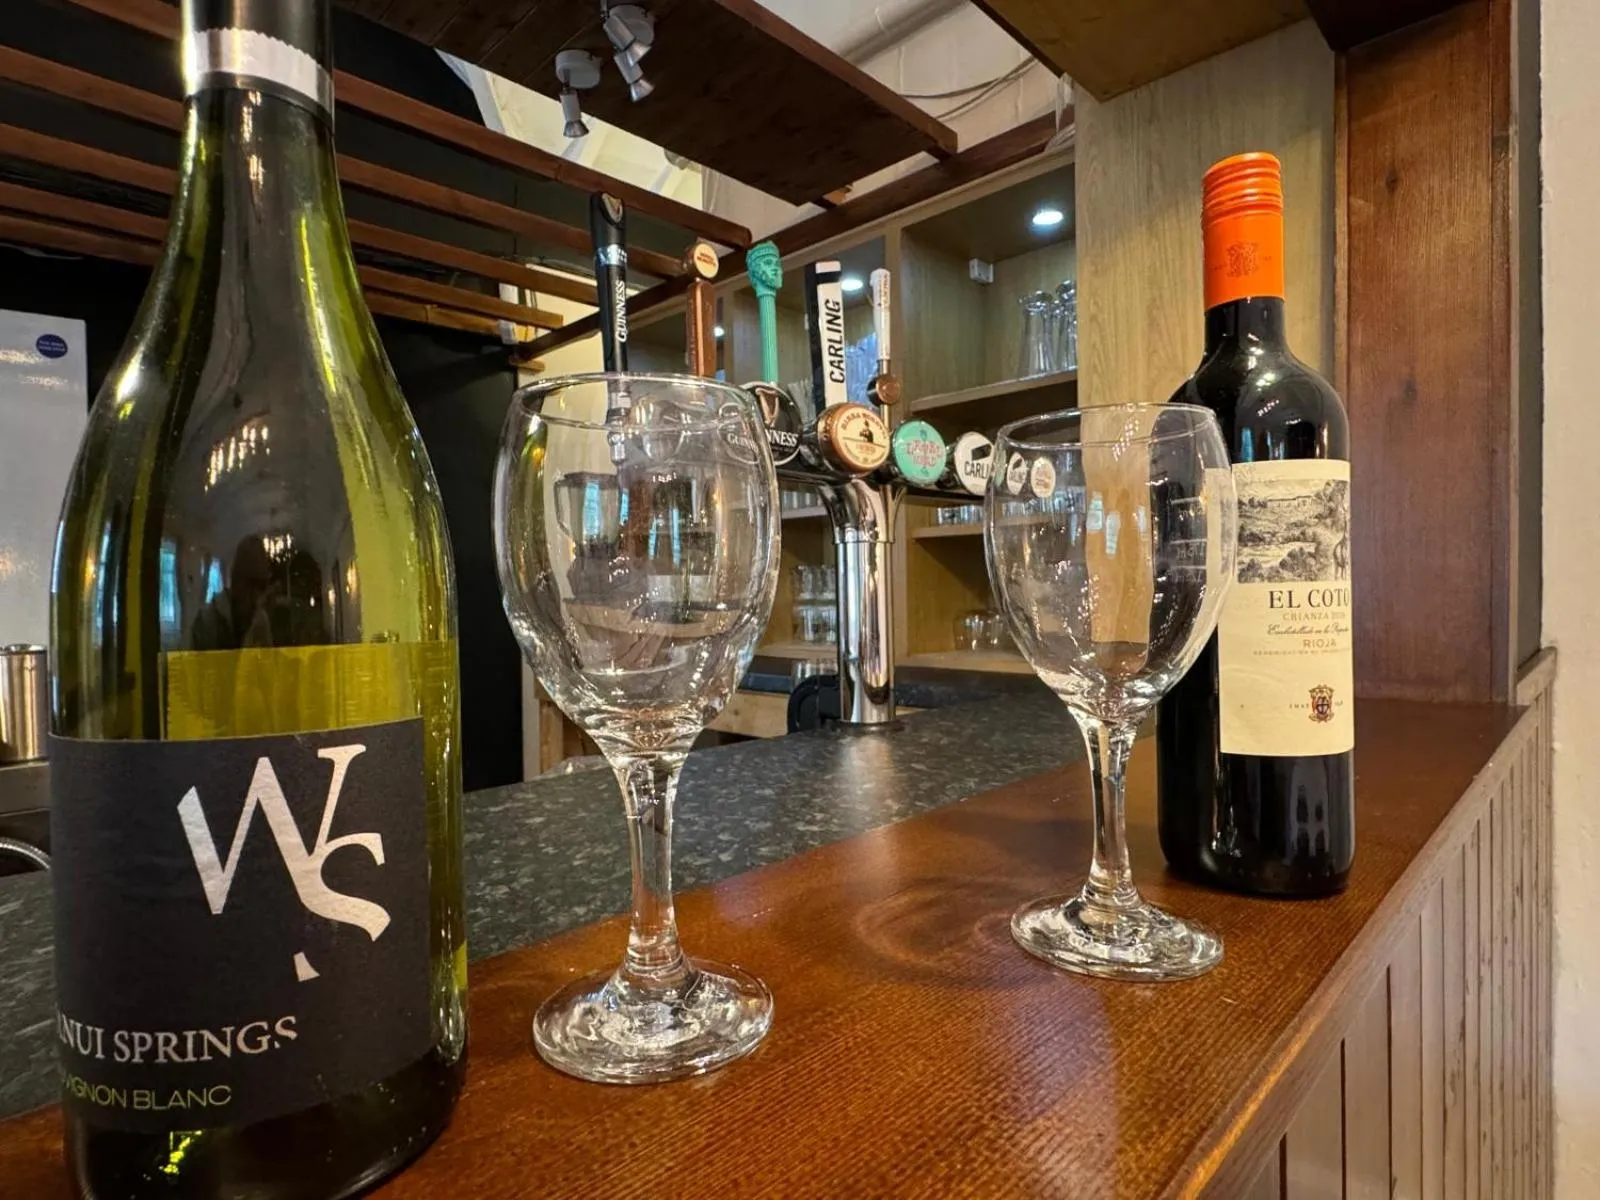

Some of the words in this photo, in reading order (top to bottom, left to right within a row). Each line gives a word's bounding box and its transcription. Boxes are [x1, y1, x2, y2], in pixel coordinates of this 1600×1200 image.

[614, 280, 628, 343] GUINNESS
[825, 298, 844, 384] CARLING
[1269, 590, 1301, 609] EL
[1283, 612, 1329, 621] CRIANZA
[1303, 639, 1337, 649] RIOJA
[113, 1015, 298, 1064] SPRINGS
[133, 1085, 233, 1111] BLANC
